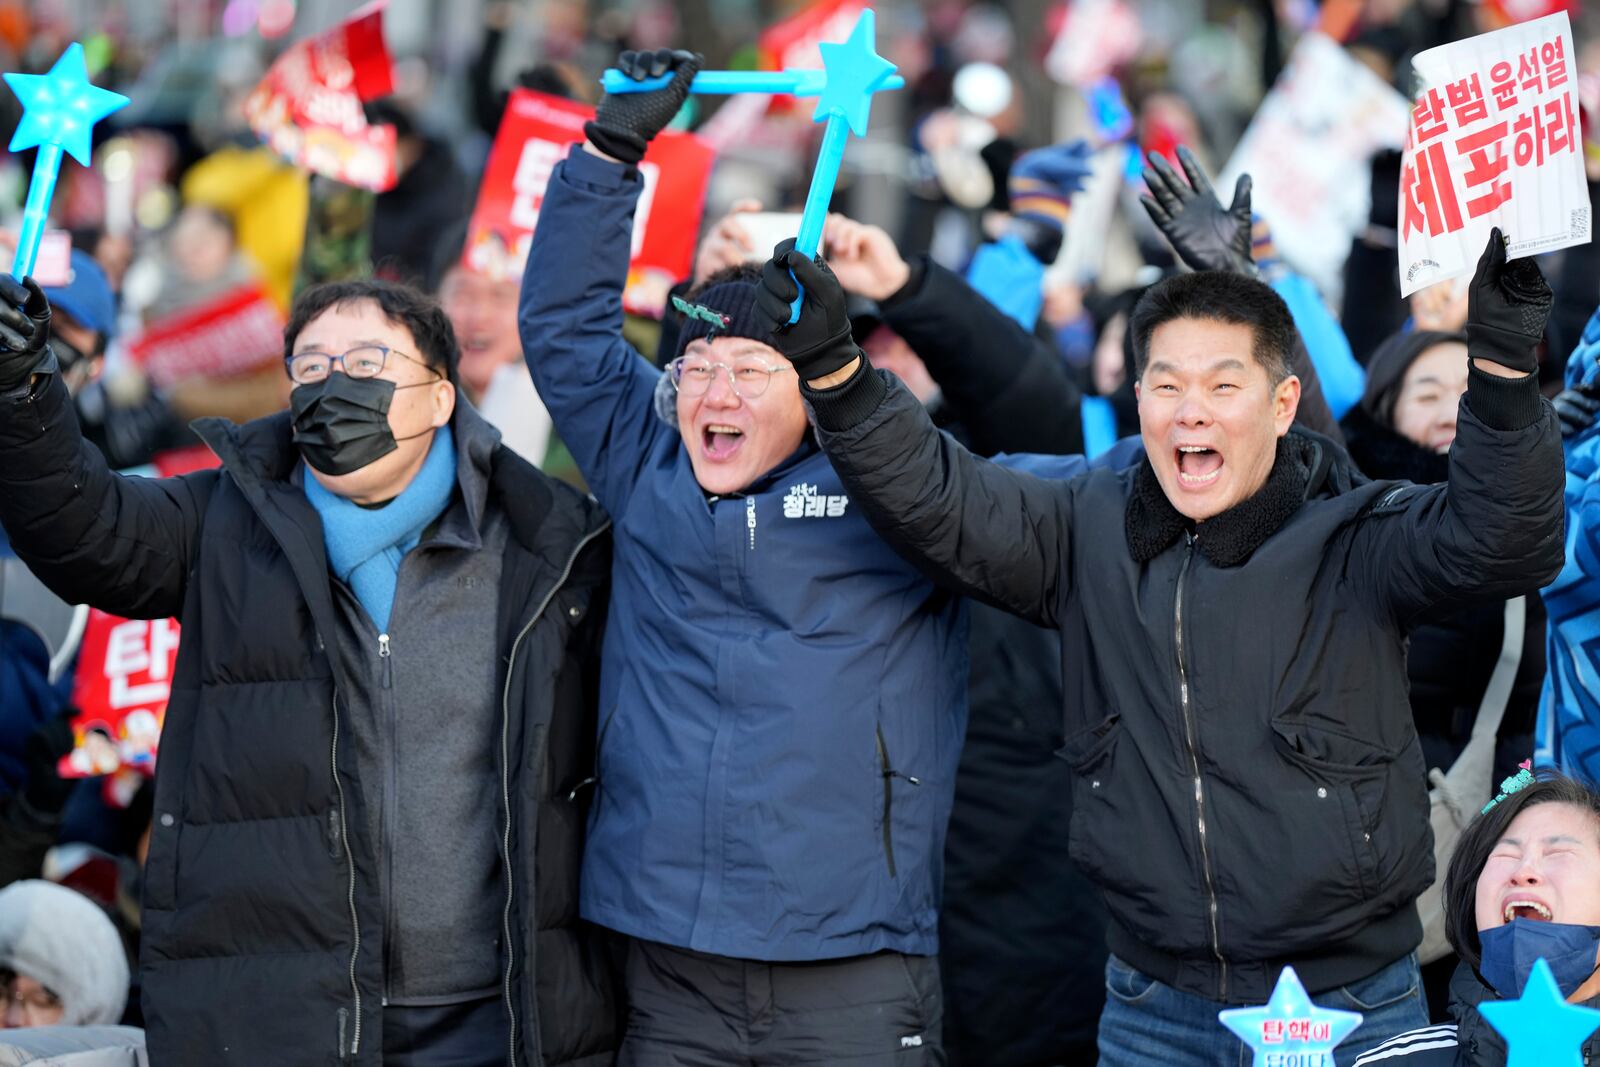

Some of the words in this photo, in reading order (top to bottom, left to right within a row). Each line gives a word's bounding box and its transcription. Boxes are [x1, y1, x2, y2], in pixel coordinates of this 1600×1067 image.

[1407, 72, 1488, 150] 란범
[1490, 35, 1568, 111] 윤석열
[1402, 91, 1575, 245] 체포하라
[1263, 1020, 1330, 1041] 탄핵이
